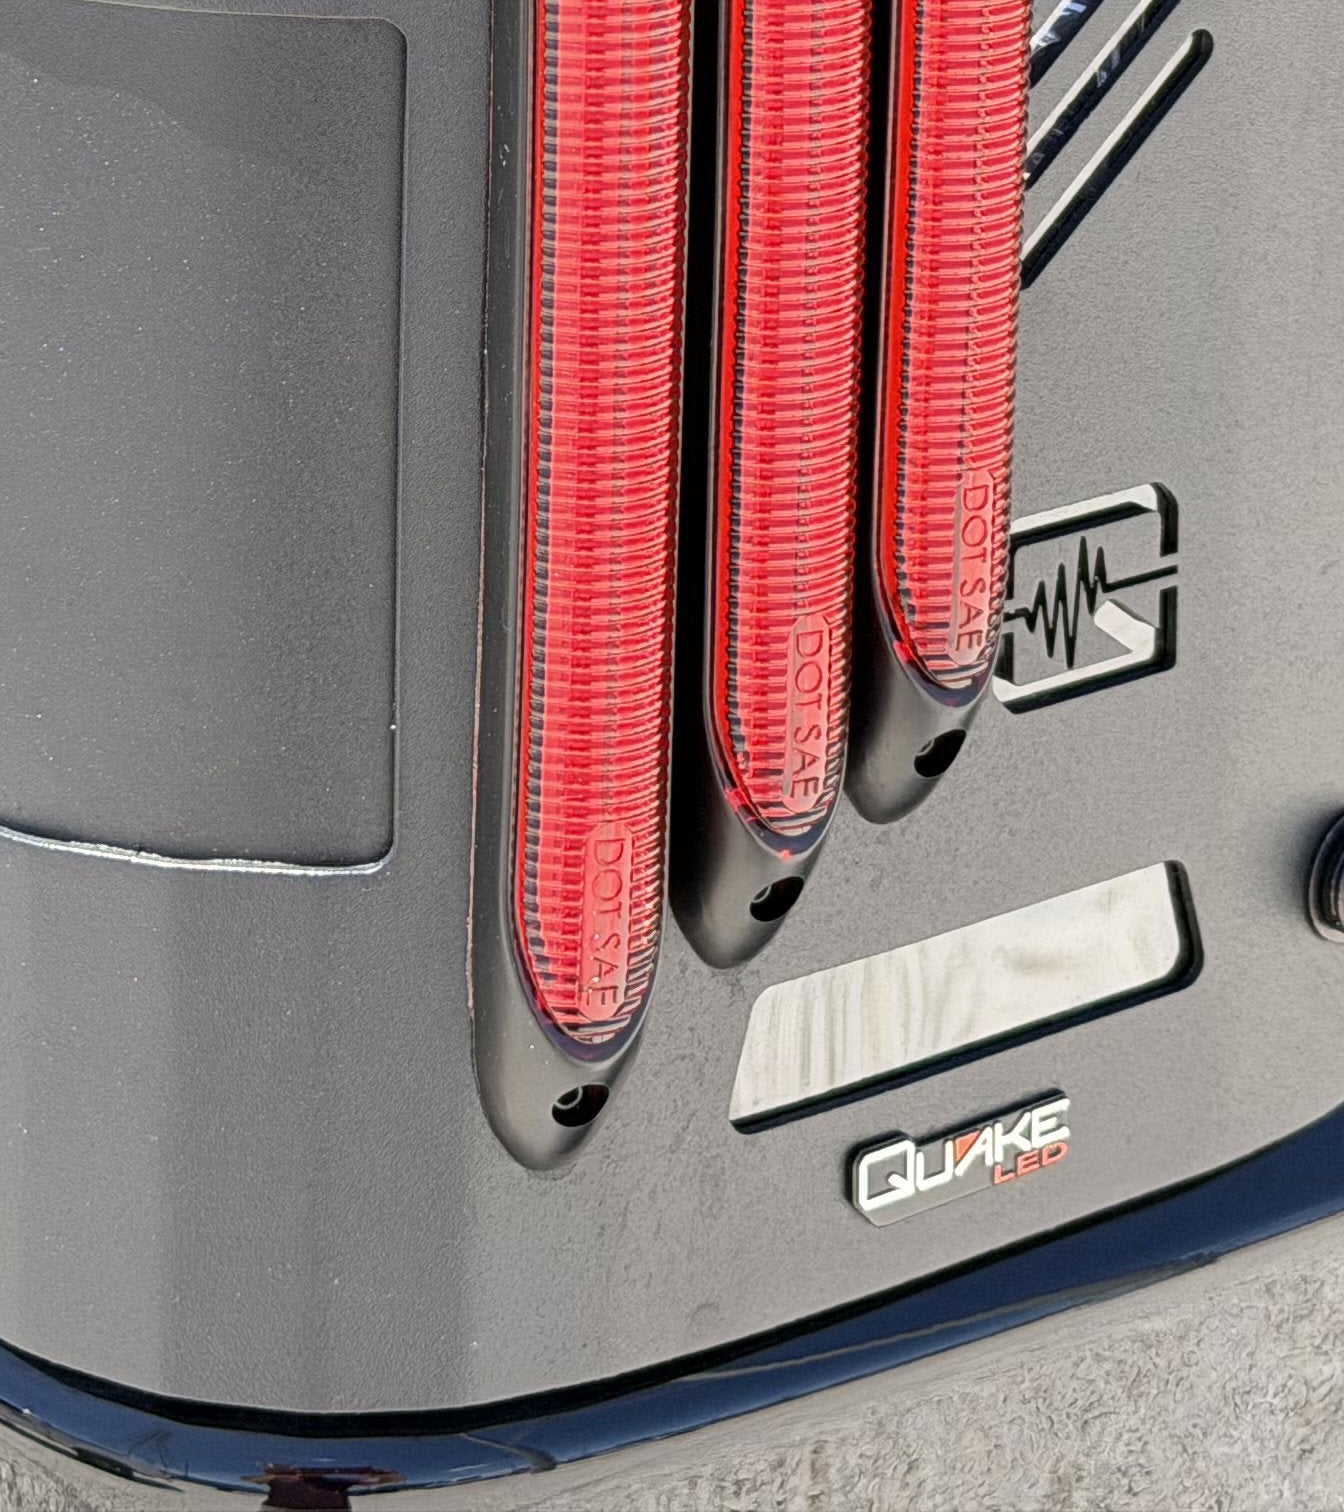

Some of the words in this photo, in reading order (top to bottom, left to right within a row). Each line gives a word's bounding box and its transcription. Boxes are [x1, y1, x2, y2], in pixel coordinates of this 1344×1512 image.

[961, 484, 989, 563] DOT
[956, 577, 986, 652] SAE
[794, 630, 824, 711] DOT
[790, 724, 822, 797] SAE
[592, 838, 626, 918] DOT
[586, 932, 622, 1006] SAE
[993, 1141, 1070, 1186] LED
